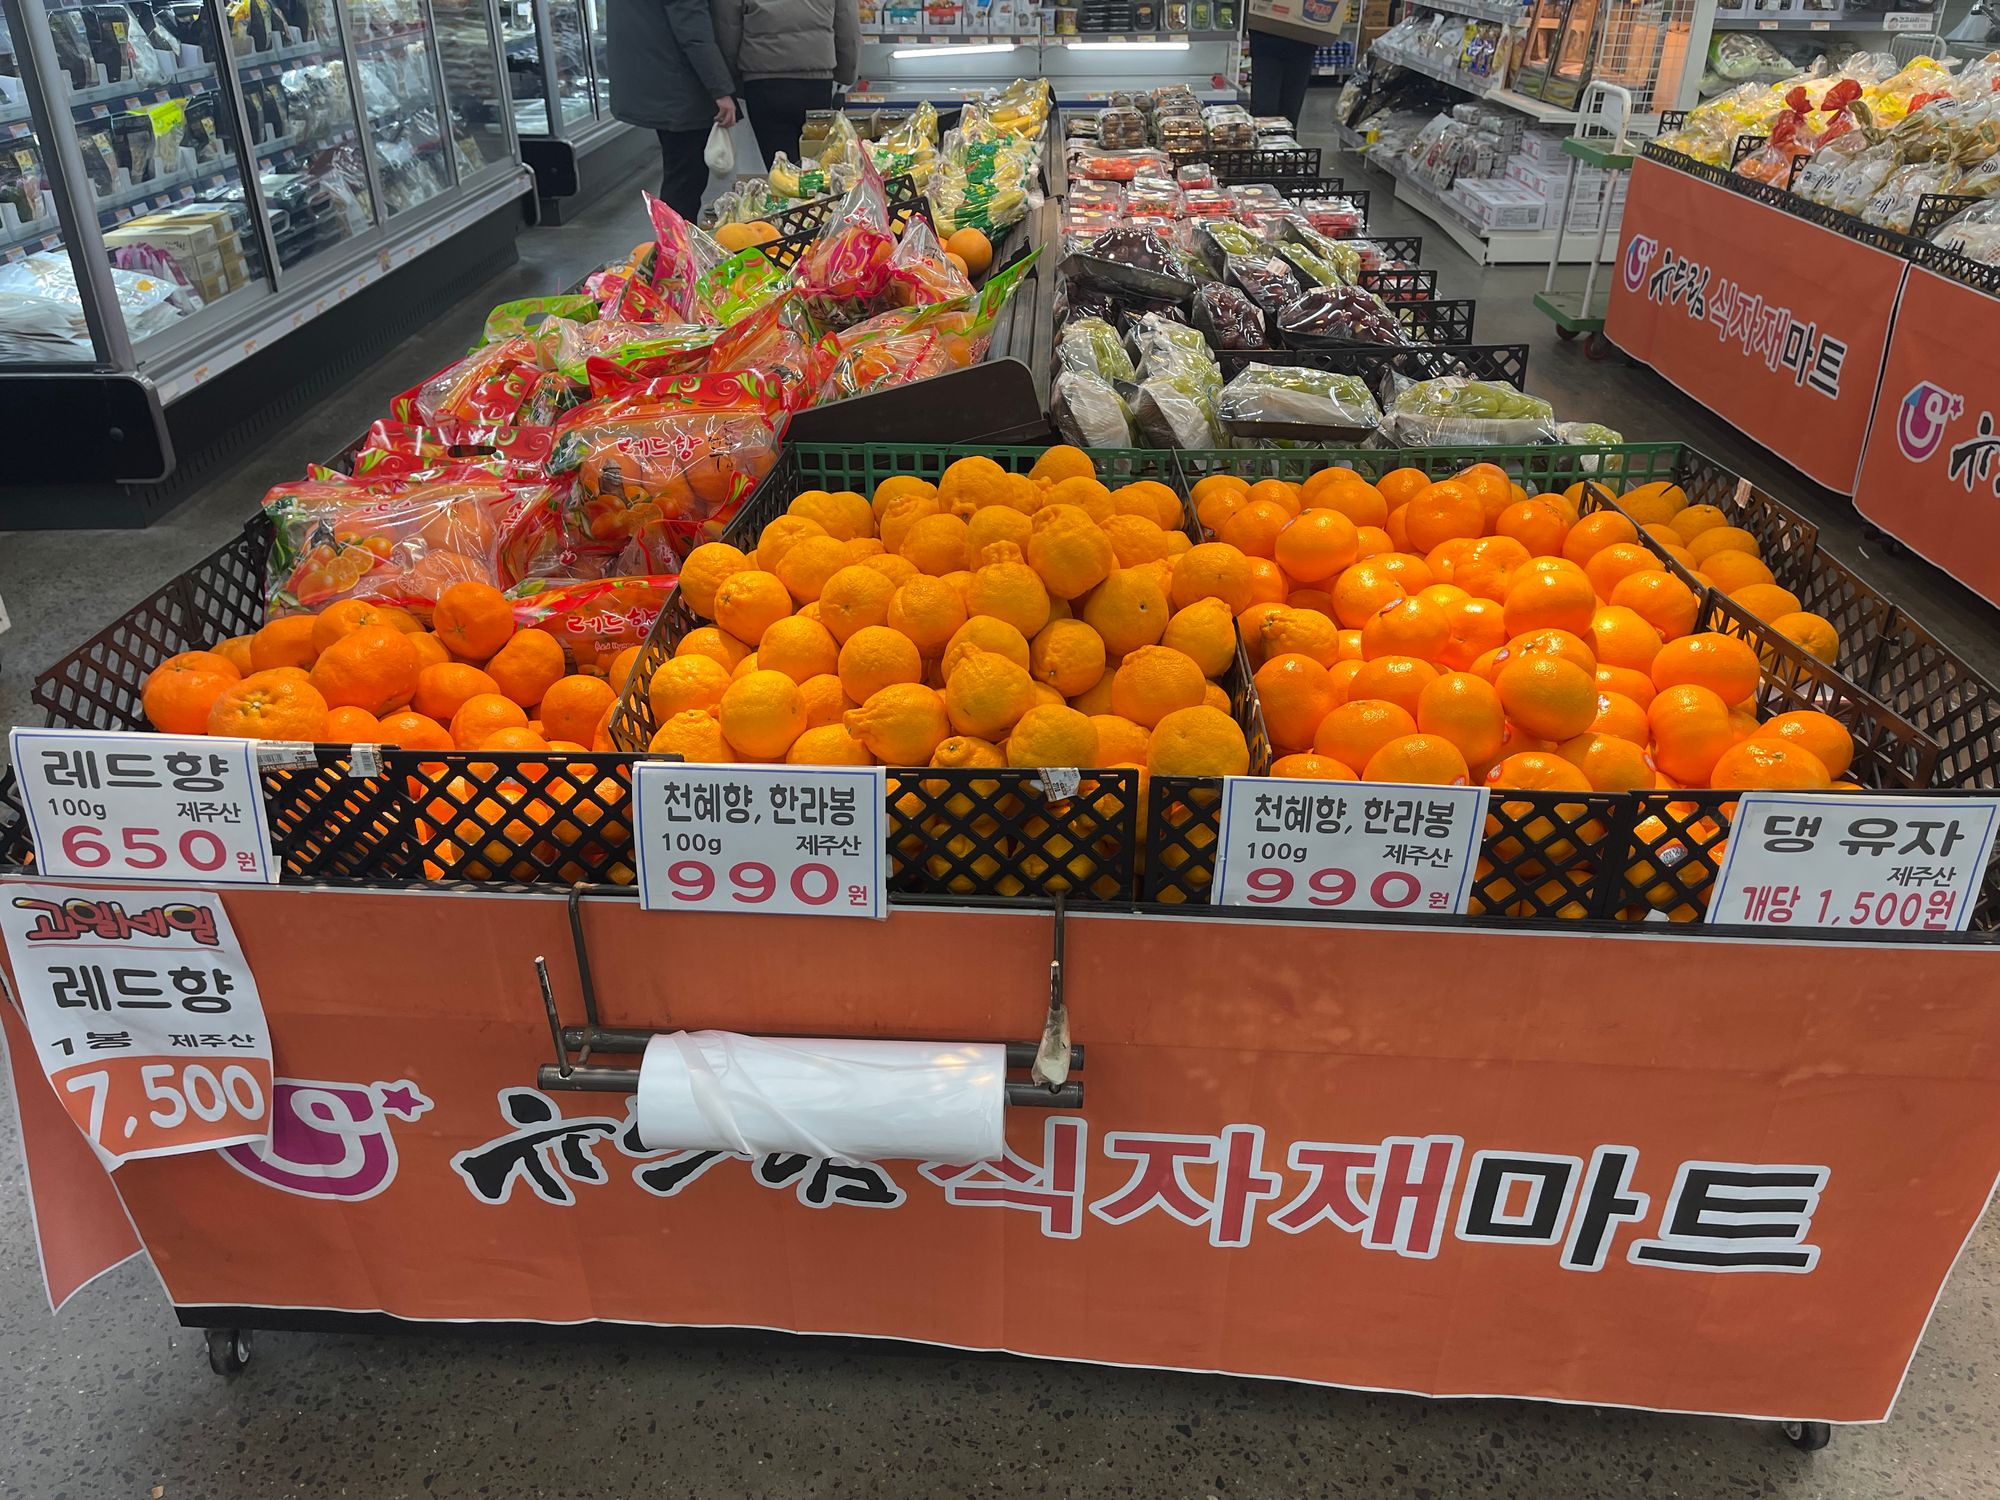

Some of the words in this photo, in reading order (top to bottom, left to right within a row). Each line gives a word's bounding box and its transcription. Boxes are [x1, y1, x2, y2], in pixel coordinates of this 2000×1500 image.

[1709, 279, 1848, 401] 식자재마트
[616, 434, 704, 462] 레드향
[566, 607, 659, 639] 레드향
[41, 750, 230, 792] 레드향
[48, 798, 107, 820] 100g
[176, 802, 242, 823] 제주산
[663, 782, 762, 825] 천혜향,
[769, 783, 857, 826] 한라봉
[1254, 793, 1353, 835] 천혜향,
[1364, 797, 1456, 839] 한라봉
[662, 832, 722, 855] 100g
[796, 835, 862, 856] 제주산
[1247, 842, 1308, 863] 100g
[1382, 844, 1454, 868] 제주산
[1763, 815, 1824, 853] 댕
[1838, 818, 1965, 857] 유자
[1886, 866, 1957, 887] 제주산
[12, 897, 220, 946] 과일세일
[1742, 886, 1801, 923] 개당
[1817, 890, 1957, 930] 1,500원
[47, 965, 234, 1014] 레드향
[168, 1034, 256, 1049] 제주산
[66, 1063, 265, 1146] 7,500
[918, 1116, 1831, 1273] 식자재마트
